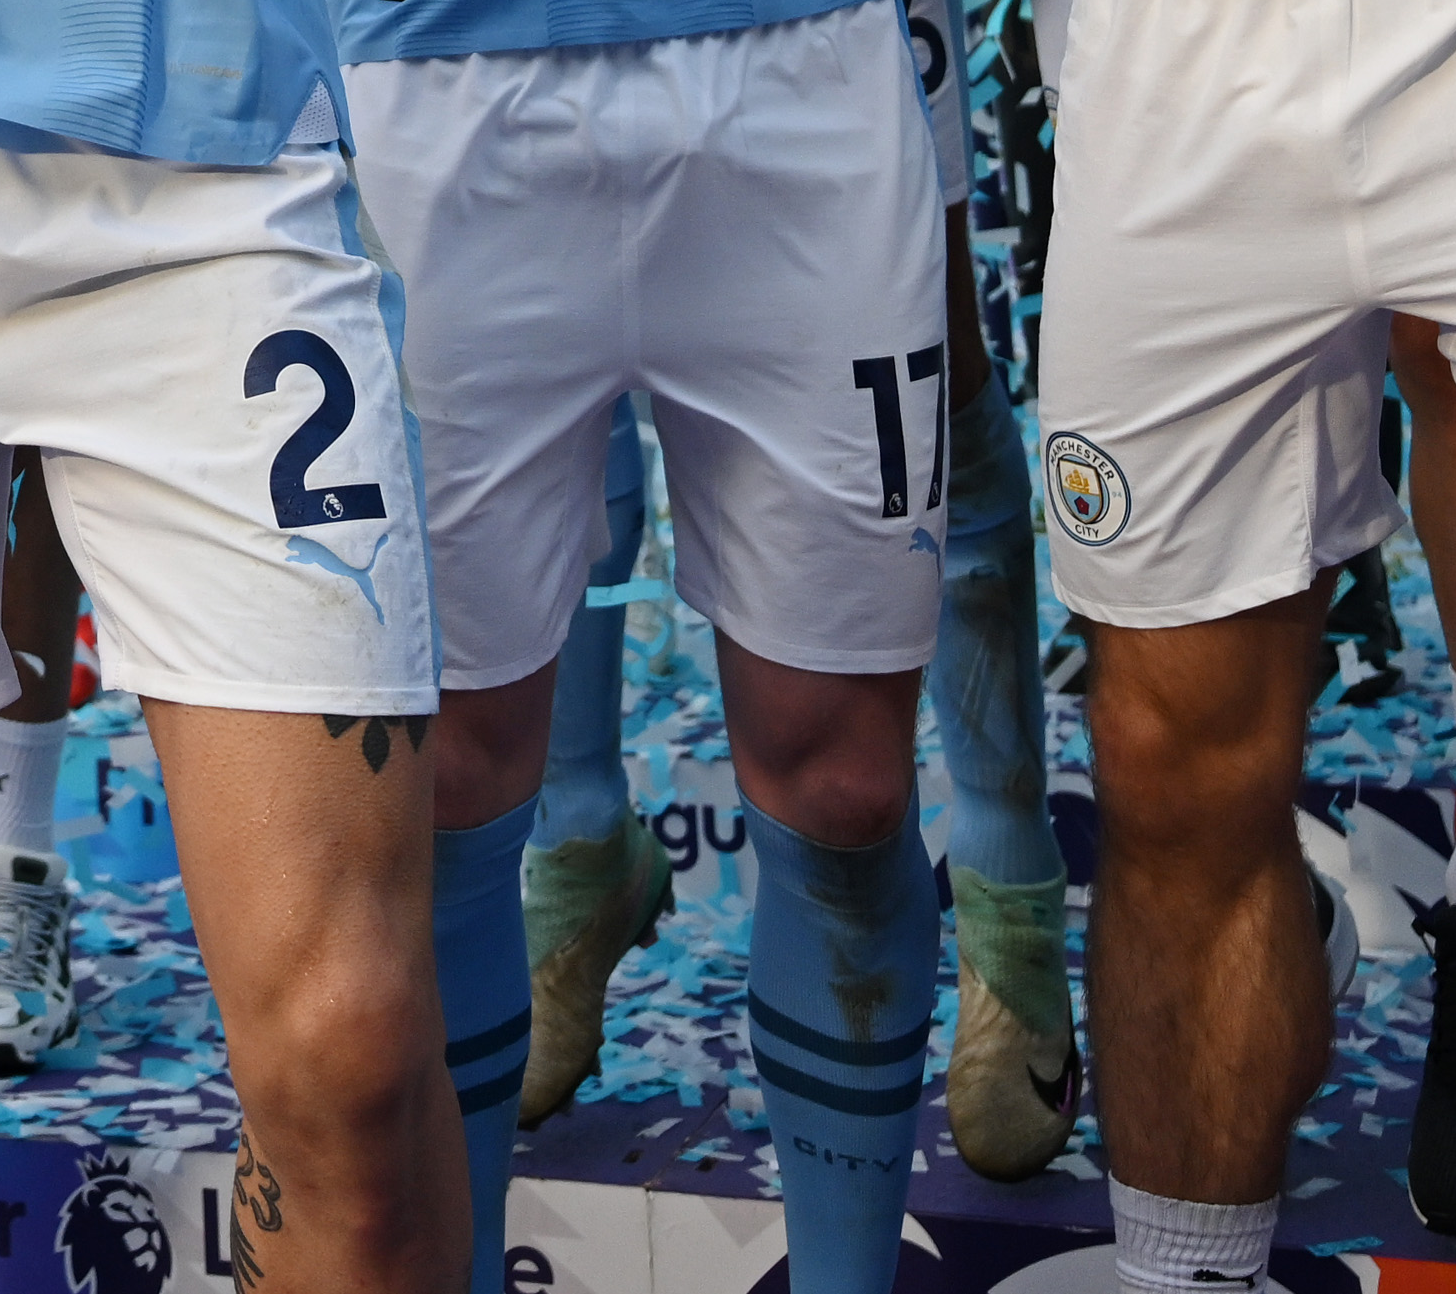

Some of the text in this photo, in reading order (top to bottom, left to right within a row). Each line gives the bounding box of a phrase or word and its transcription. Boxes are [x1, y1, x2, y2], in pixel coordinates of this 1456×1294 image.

[243, 329, 387, 529] 2
[852, 341, 945, 519] 17
[1048, 438, 1115, 481] MANCHESTER
[1074, 524, 1101, 540] CITY
[793, 1134, 901, 1175] CITY
